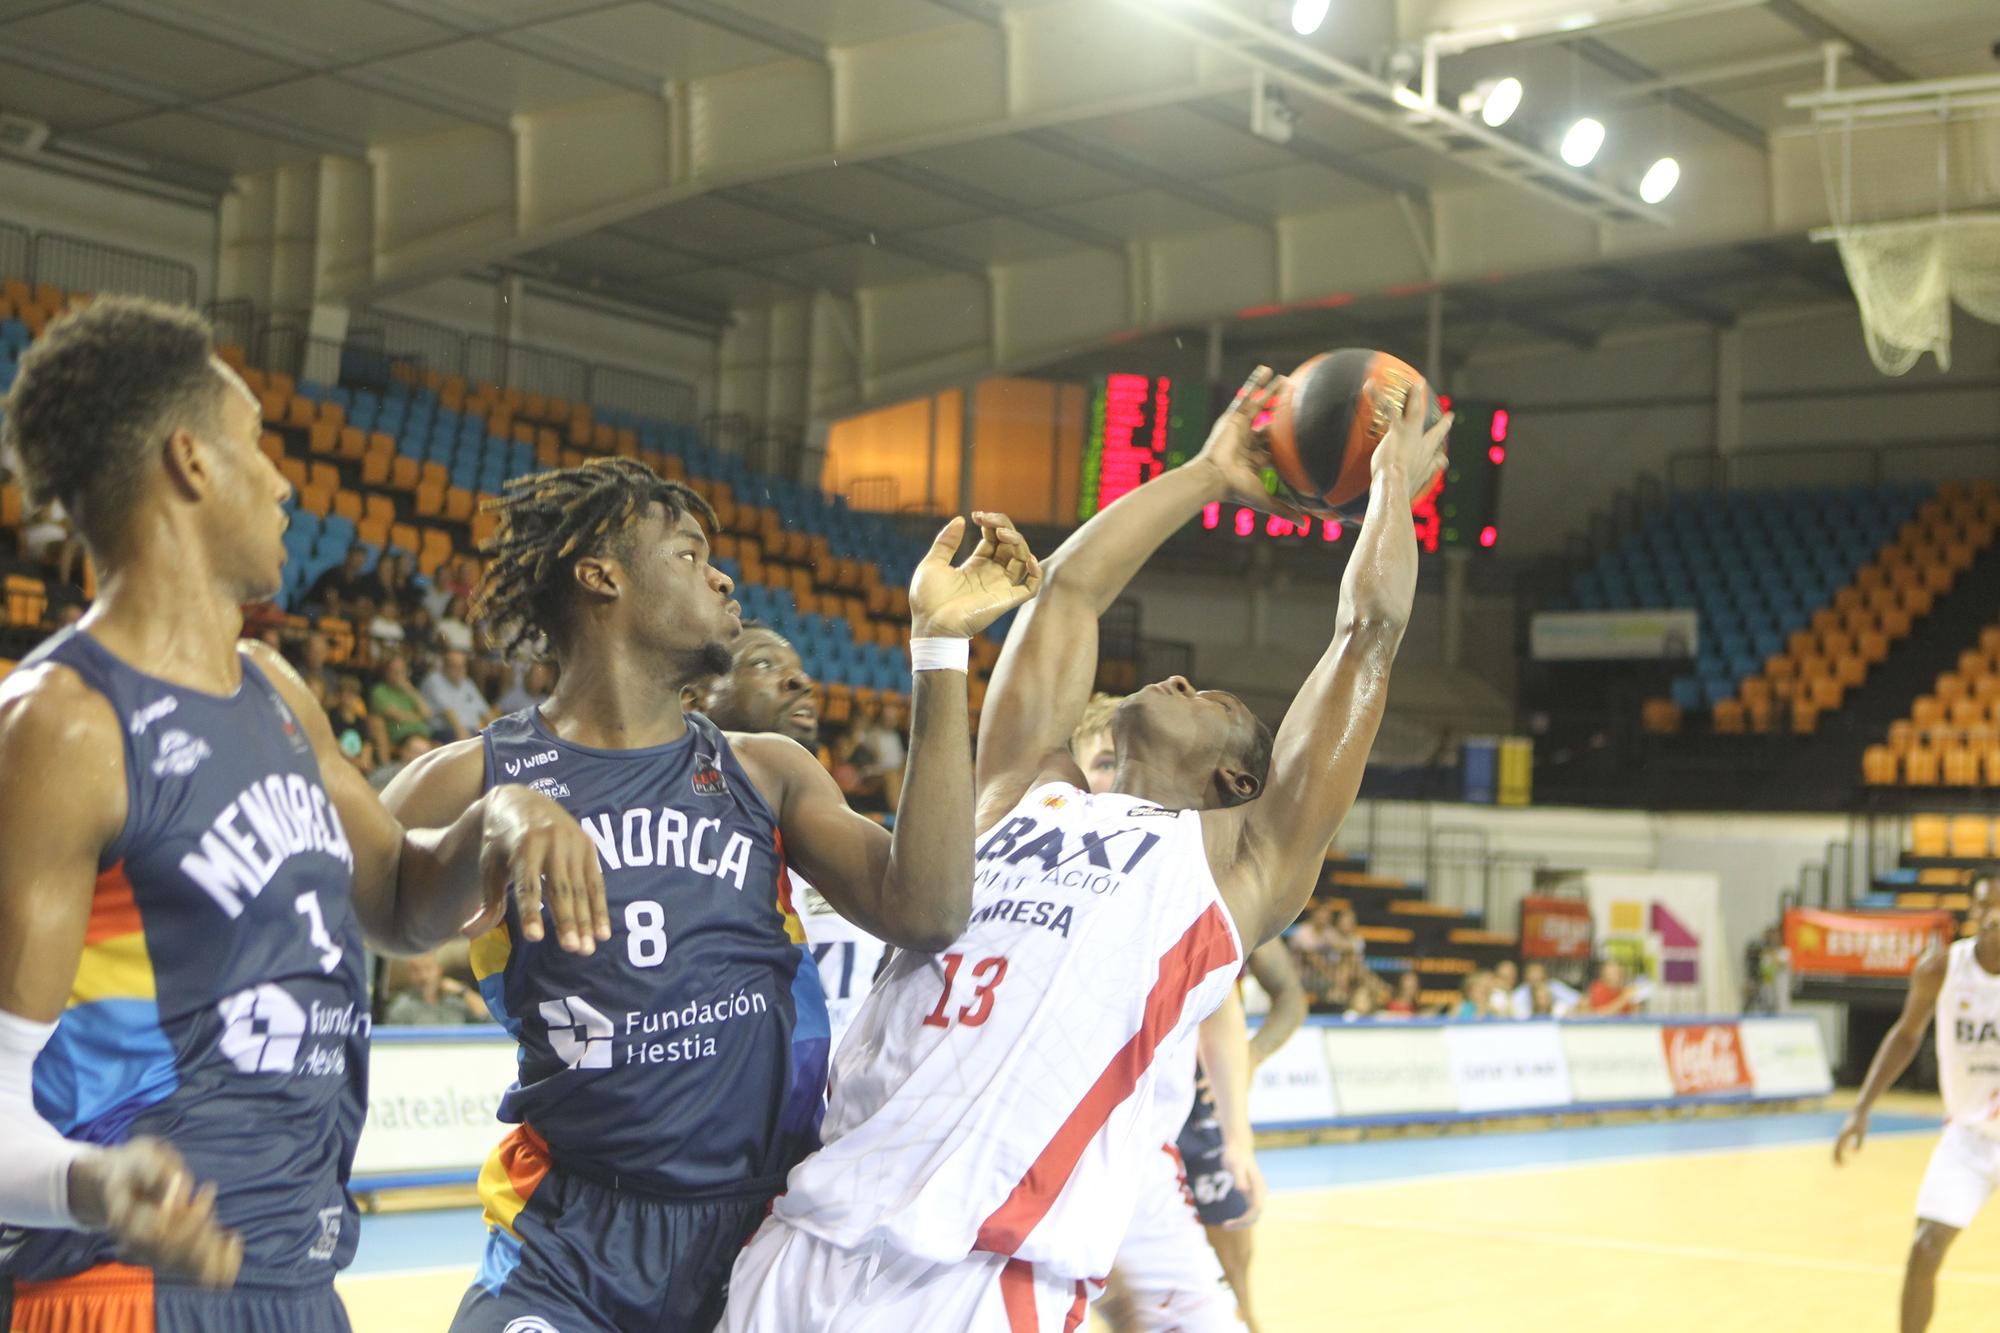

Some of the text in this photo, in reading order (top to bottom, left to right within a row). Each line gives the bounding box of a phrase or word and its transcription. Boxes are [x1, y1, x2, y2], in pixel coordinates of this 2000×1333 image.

[523, 750, 559, 768] WIBO
[581, 807, 753, 891] NORCA
[975, 815, 1161, 875] BAXI
[295, 889, 343, 975] 1
[624, 900, 668, 968] 8
[626, 988, 767, 1035] Fundación
[922, 951, 1009, 1029] 13
[626, 1034, 717, 1065] Hestia
